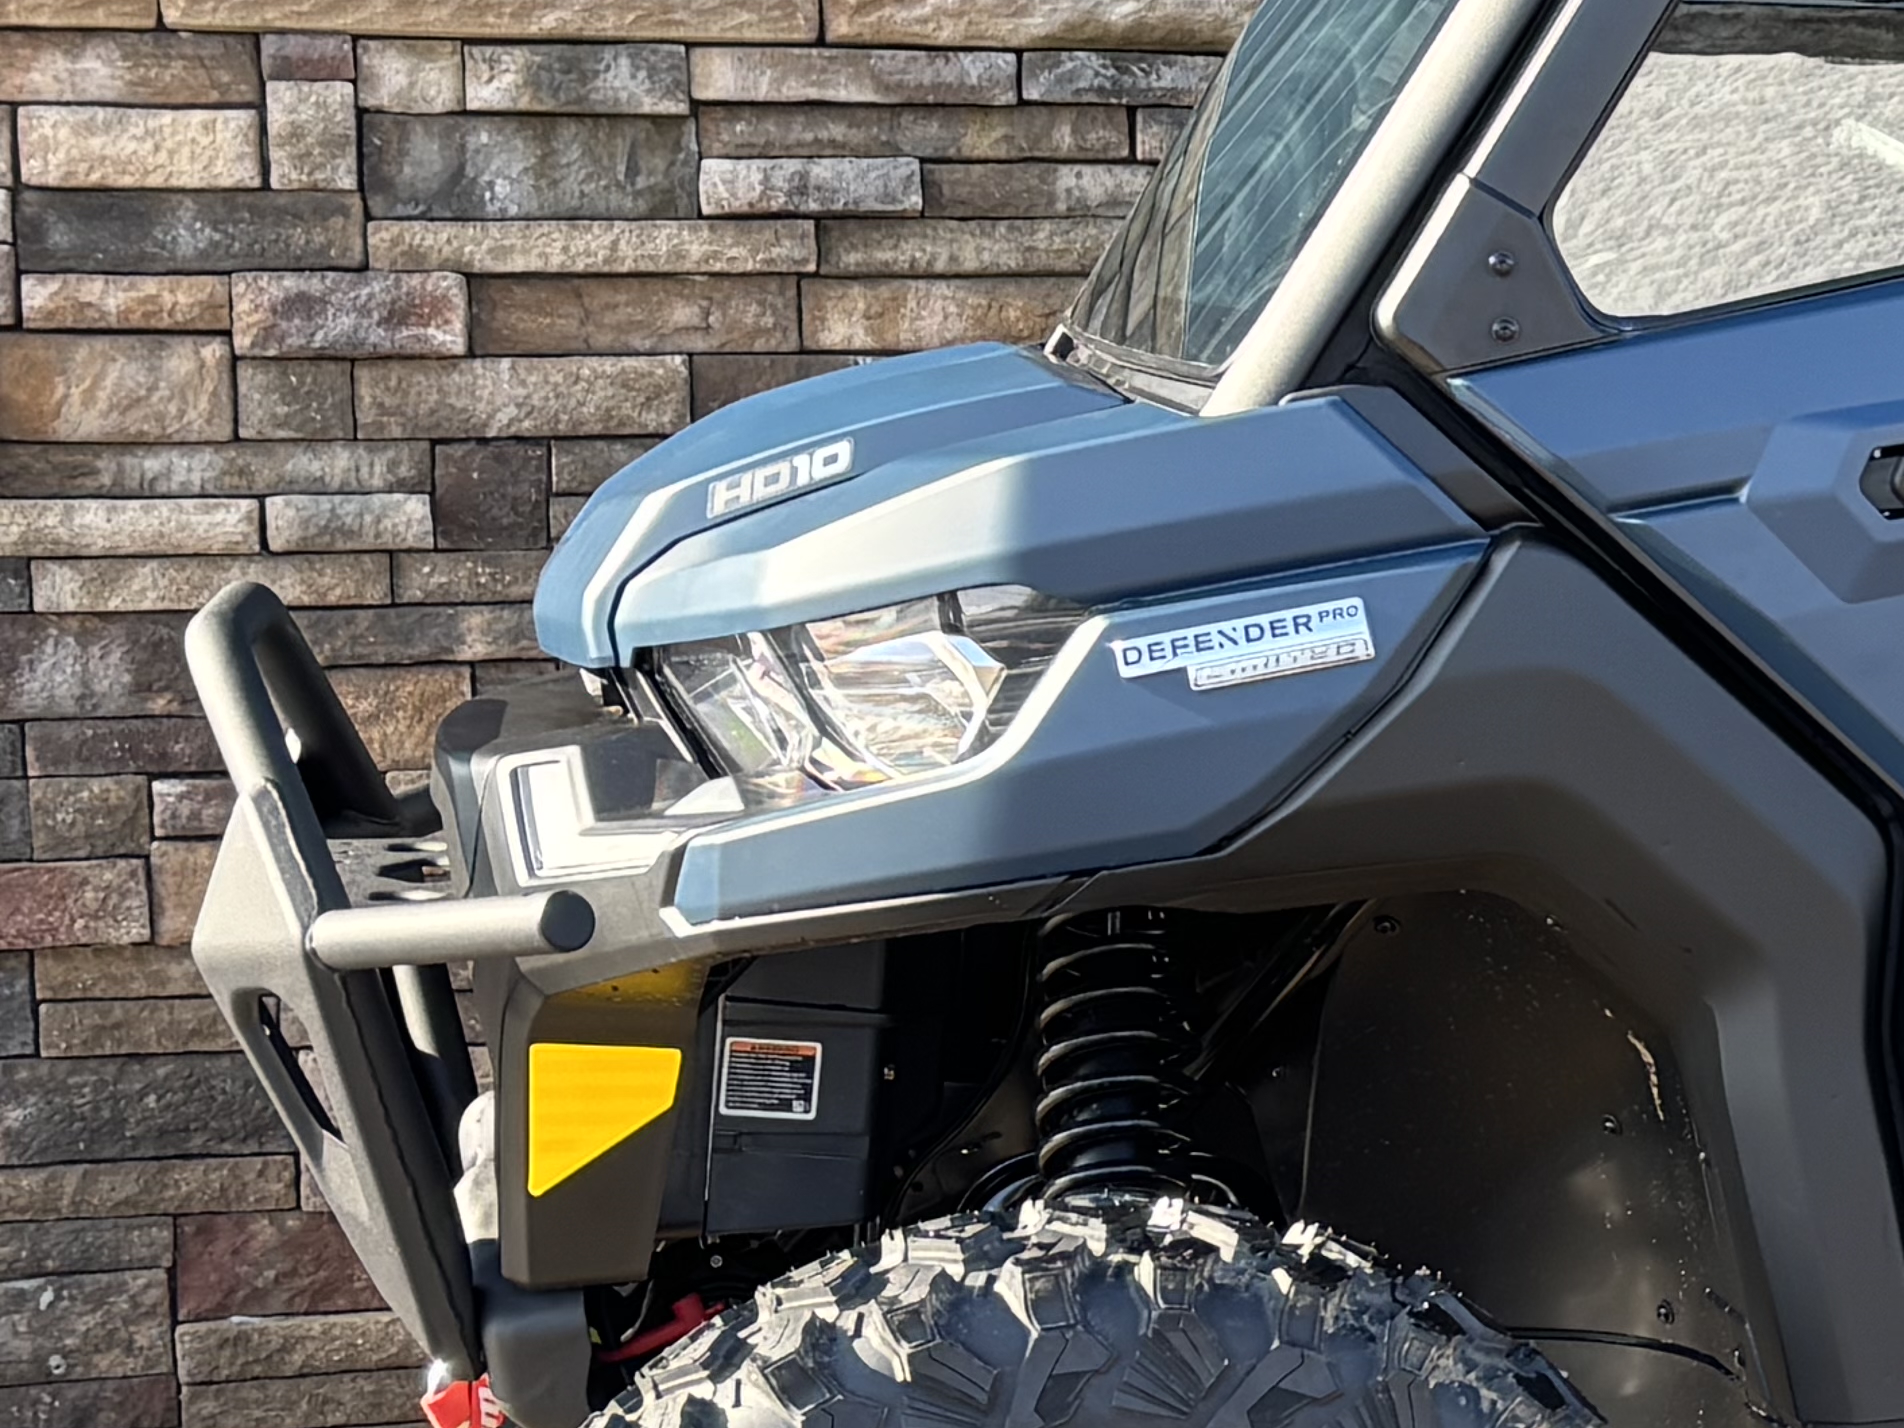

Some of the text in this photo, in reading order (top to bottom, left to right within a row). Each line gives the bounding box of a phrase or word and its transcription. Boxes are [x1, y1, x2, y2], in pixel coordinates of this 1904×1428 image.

[711, 438, 853, 517] HD10
[1122, 604, 1360, 667] DEFENDER PRO
